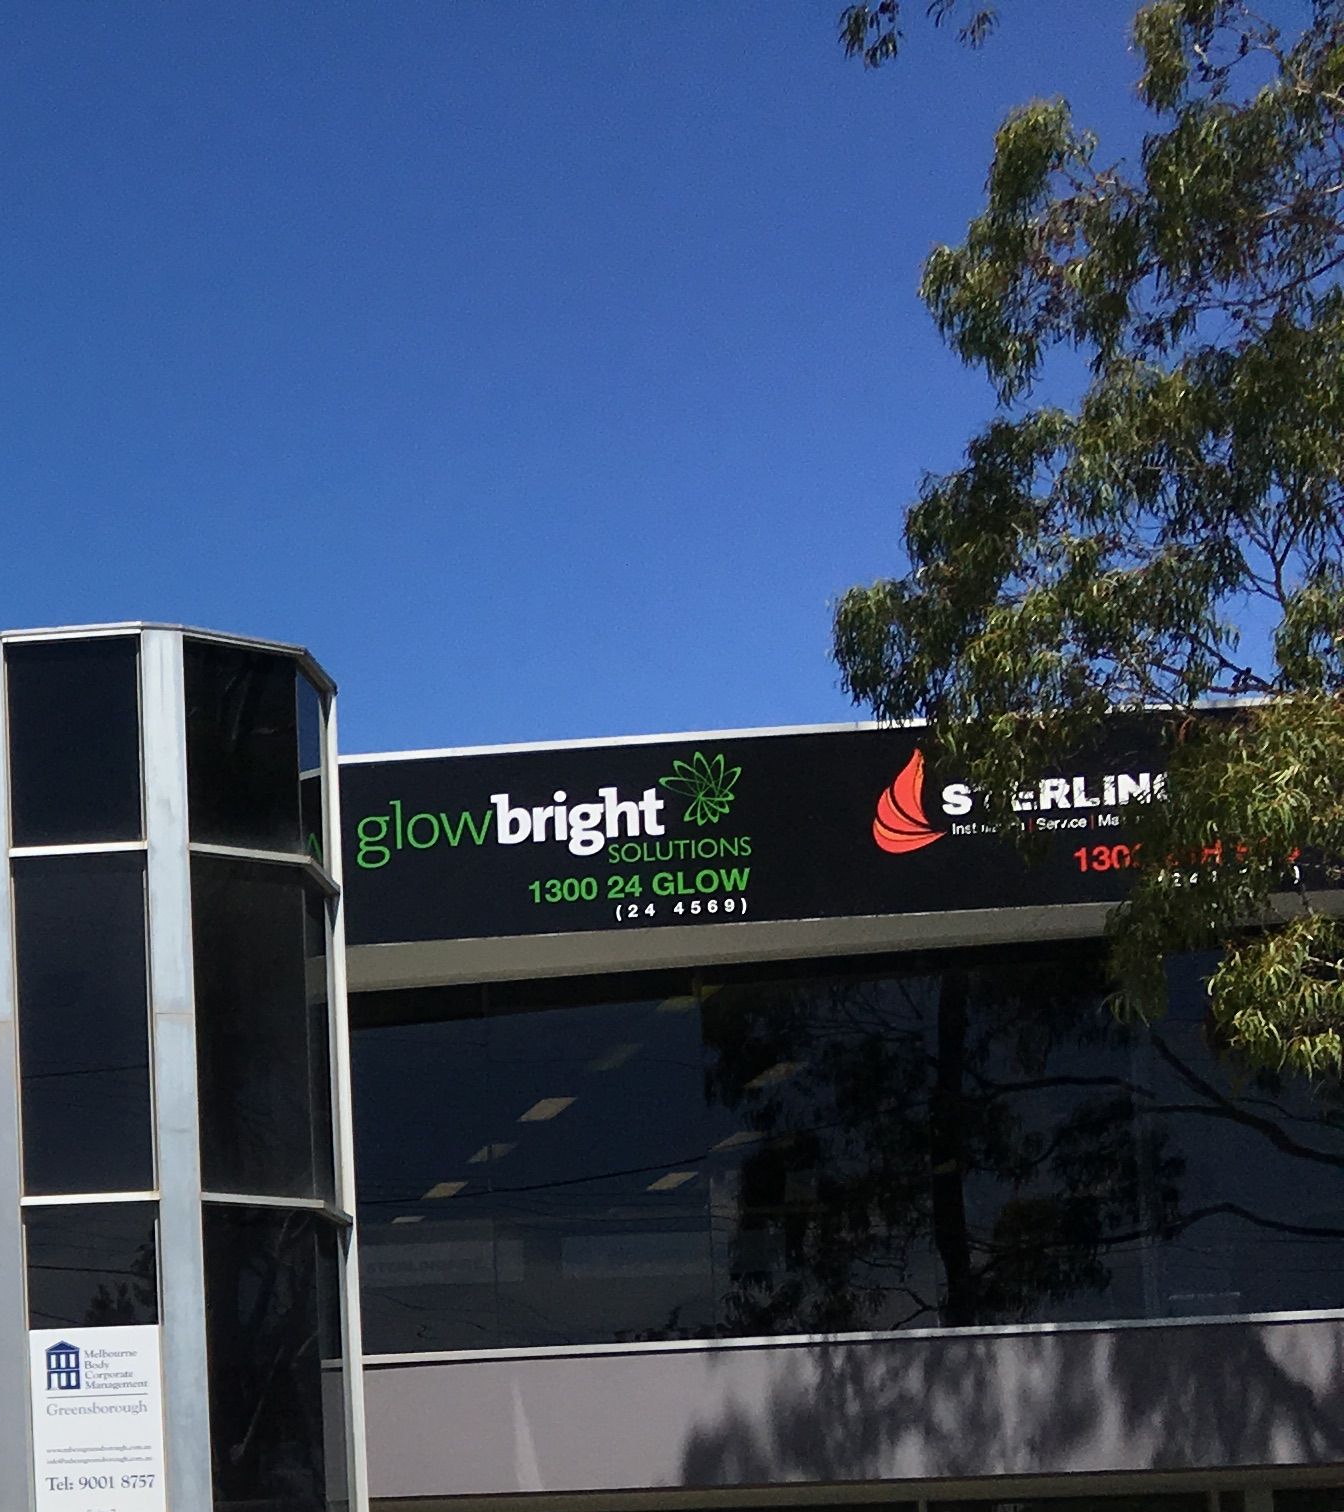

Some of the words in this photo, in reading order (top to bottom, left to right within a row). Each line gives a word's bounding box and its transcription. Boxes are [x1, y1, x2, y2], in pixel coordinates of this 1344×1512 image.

[941, 772, 1169, 816] SERLIN
[355, 787, 665, 868] glowbright
[1036, 816, 1088, 831] Servce
[608, 835, 752, 863] SOLUTIONS
[1073, 842, 1142, 873] 130
[528, 876, 599, 903] 1300
[607, 874, 643, 899] 24
[652, 867, 751, 896] GLOW
[84, 1348, 138, 1359] Melbourne
[84, 1361, 110, 1371] Body
[84, 1370, 134, 1381] Corporate
[84, 1379, 148, 1391] Management
[46, 1400, 148, 1417] Greensborough
[45, 1476, 74, 1492] Tel:
[78, 1476, 116, 1490] 9001
[120, 1473, 156, 1489] 8757
